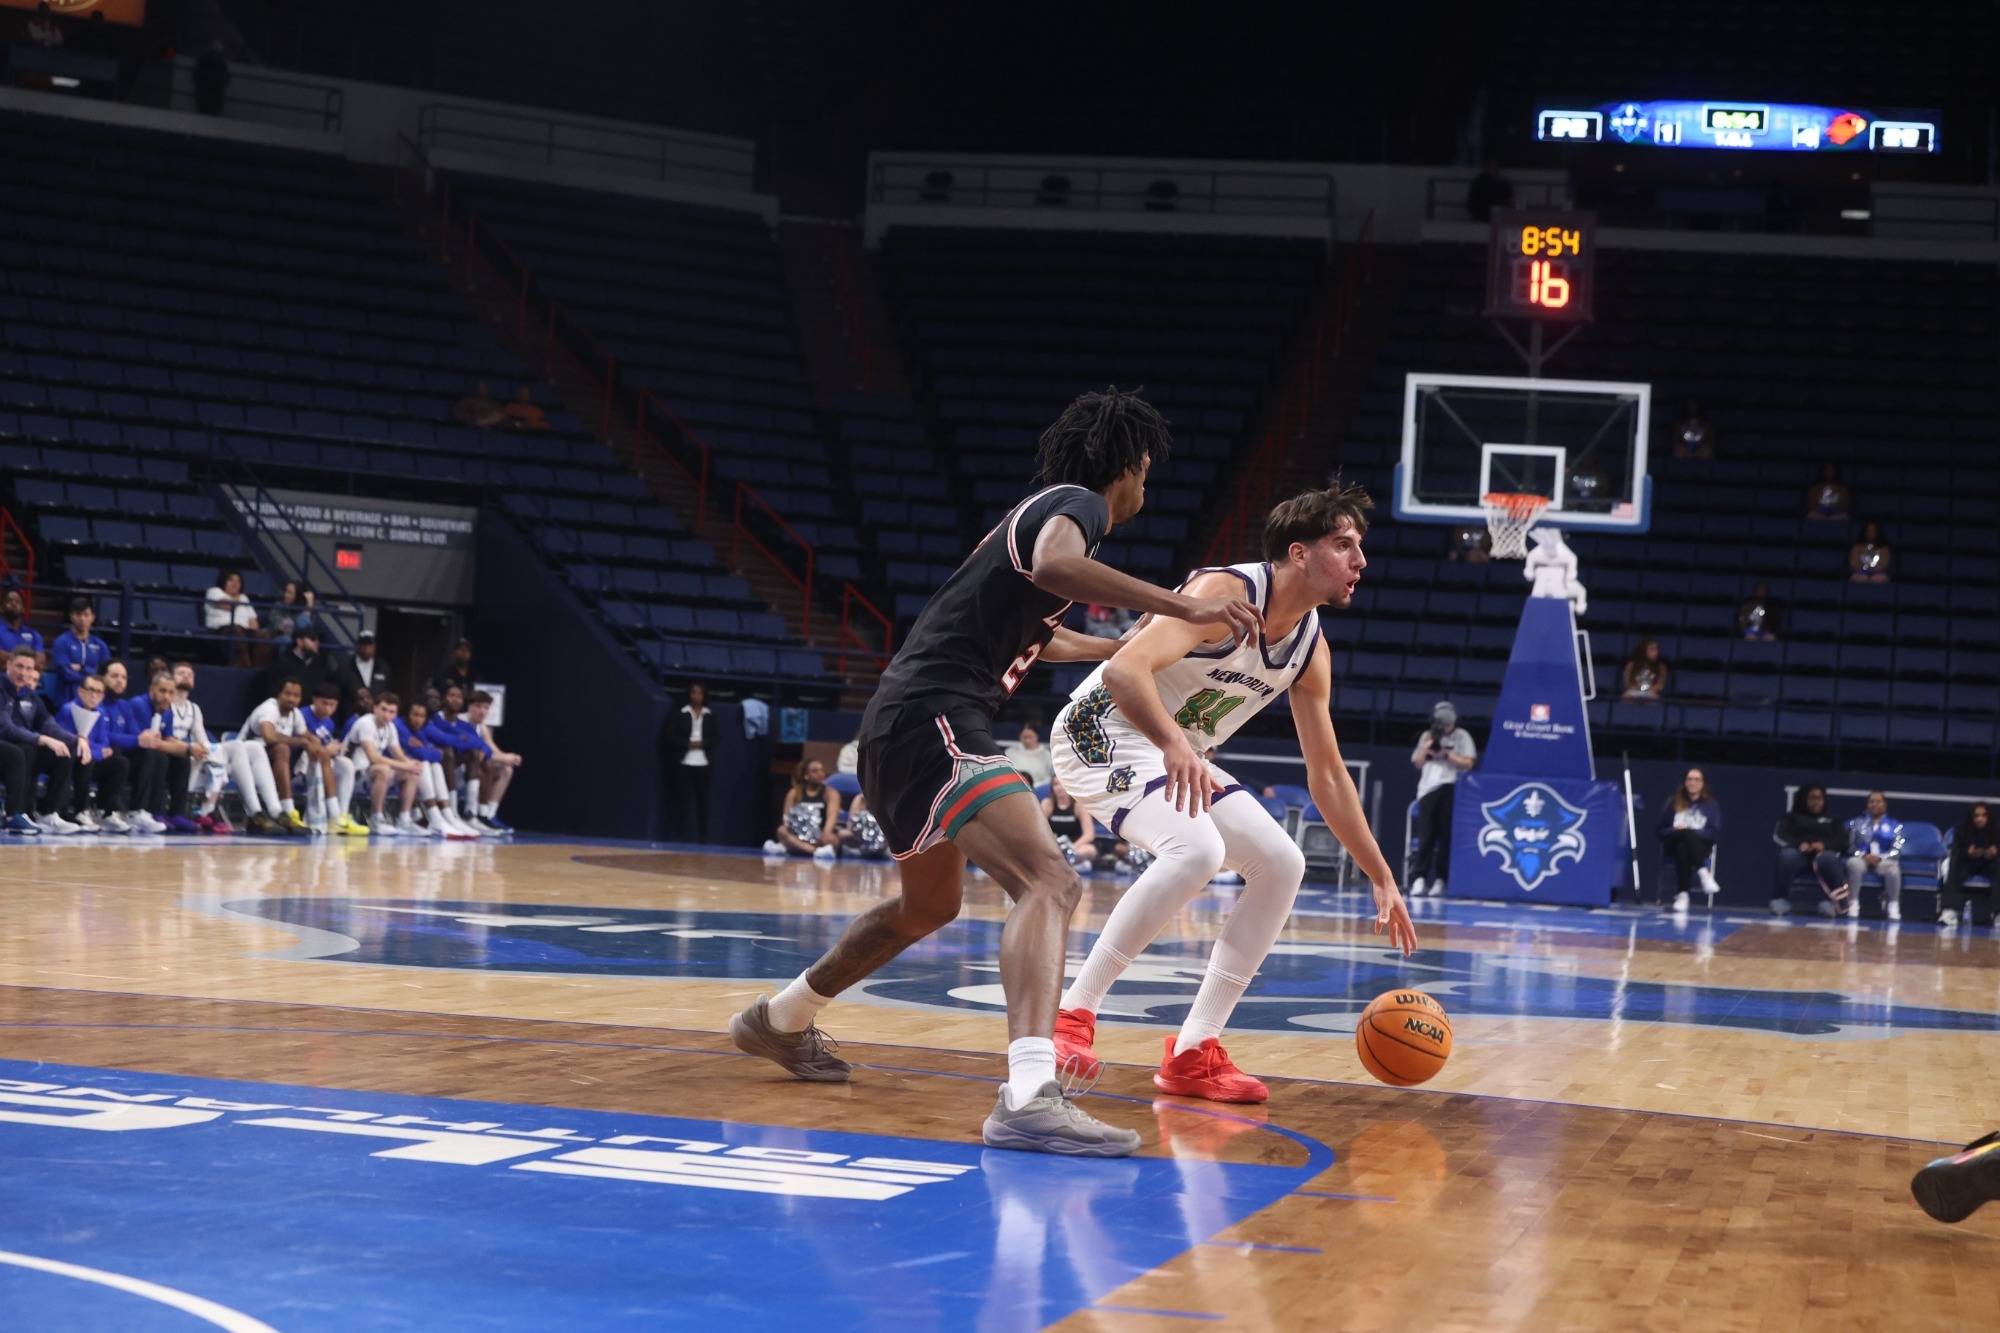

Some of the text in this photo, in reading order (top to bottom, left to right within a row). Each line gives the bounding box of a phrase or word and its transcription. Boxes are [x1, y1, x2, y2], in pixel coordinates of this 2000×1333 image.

[1521, 225, 1581, 256] 8:54
[1529, 260, 1570, 308] 16
[294, 505, 322, 520] FOOD
[333, 509, 382, 526] BEVERAGE
[1205, 668, 1246, 684] NEW
[1404, 1017, 1445, 1044] NCAA
